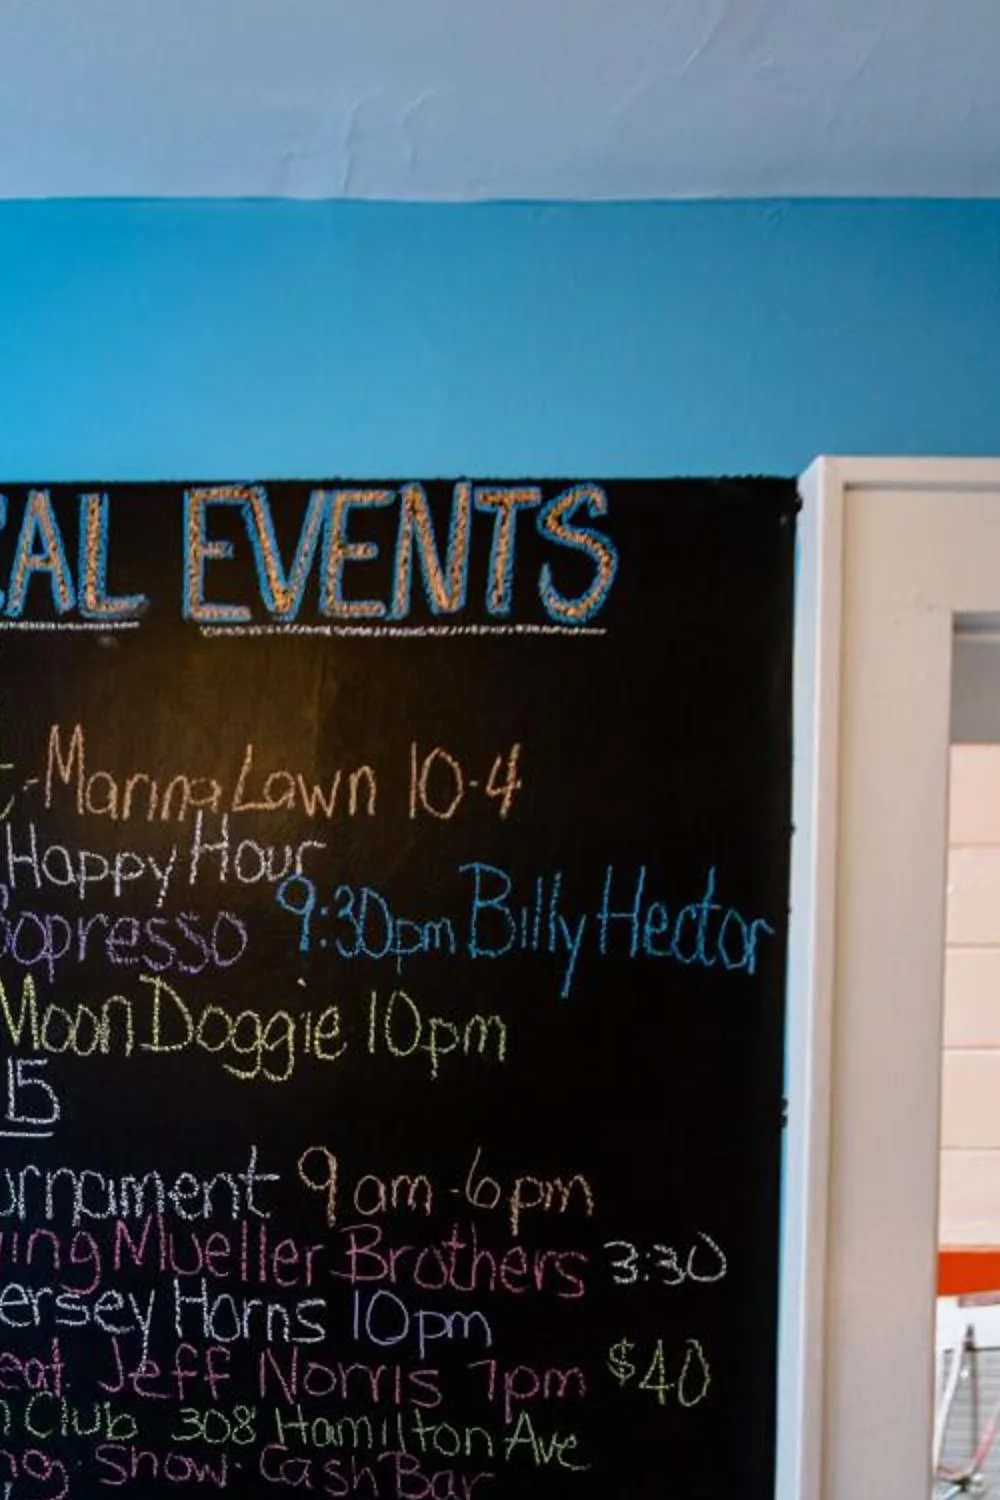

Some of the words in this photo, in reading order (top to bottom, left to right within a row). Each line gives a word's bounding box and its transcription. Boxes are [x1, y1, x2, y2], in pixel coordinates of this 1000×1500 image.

[182, 482, 619, 622] EVENTS
[232, 743, 377, 818] Lawn
[5, 822, 177, 907] Happy
[188, 808, 327, 885] Hour
[275, 872, 456, 973] 9:30pm
[459, 861, 585, 998] Billy
[597, 865, 776, 975] Hector
[138, 973, 348, 1082] Doggie
[367, 989, 508, 1080] 10pm
[5, 1056, 62, 1124] 15
[114, 1212, 326, 1288] Mueller
[329, 1221, 590, 1299] Brothers
[603, 1231, 728, 1286] 3:30
[172, 1276, 326, 1343] Horns
[352, 1289, 493, 1359] 10pm
[97, 1335, 231, 1400] Jeff
[260, 1347, 443, 1408] Norris
[468, 1359, 588, 1423] 7pm
[608, 1336, 712, 1407] $40
[25, 1390, 139, 1441] Club
[171, 1402, 257, 1445] 308
[276, 1406, 495, 1458] Hamilton
[504, 1412, 591, 1471] Ave
[94, 1443, 228, 1489] Show
[259, 1444, 380, 1496] Cash
